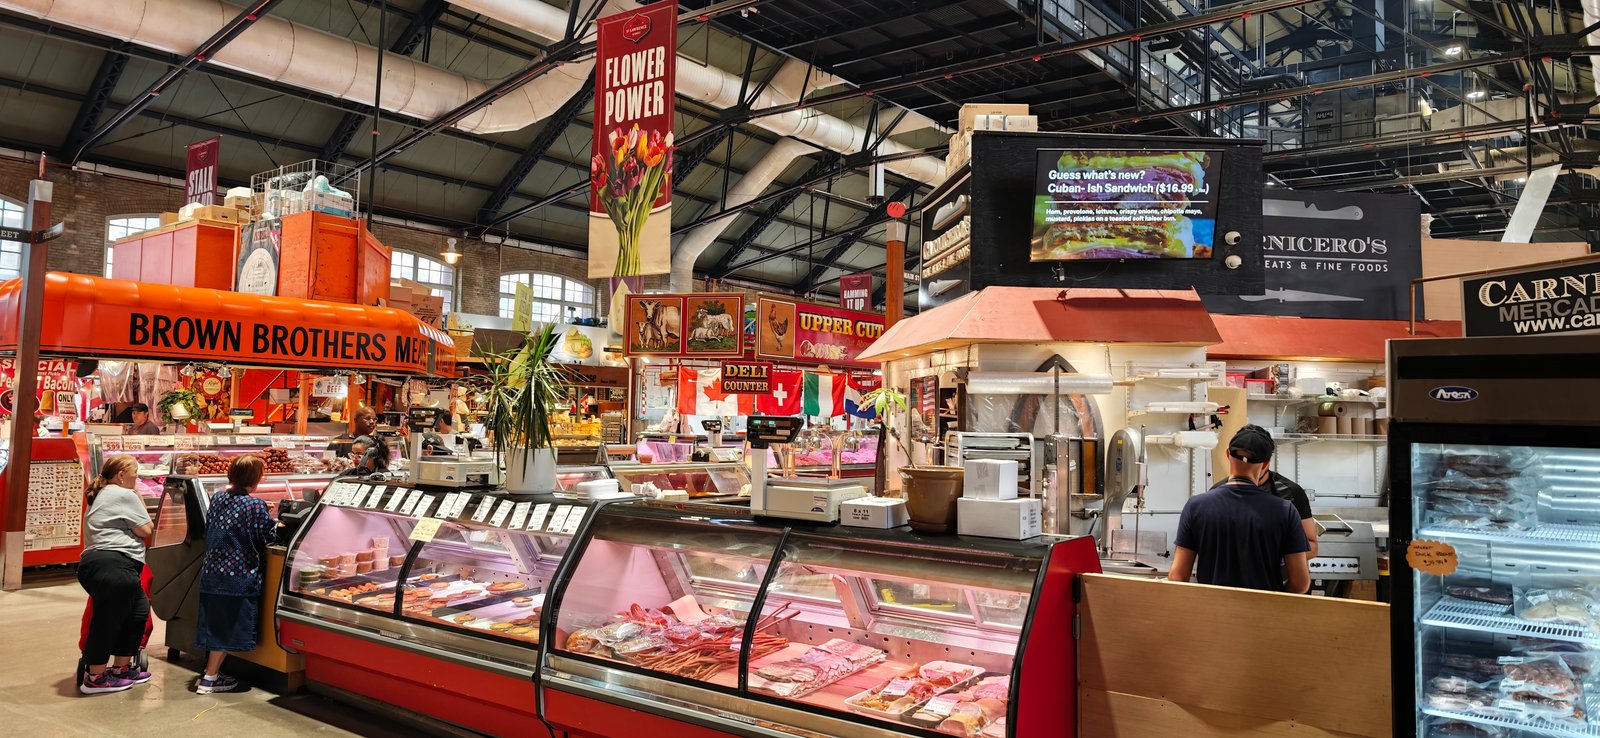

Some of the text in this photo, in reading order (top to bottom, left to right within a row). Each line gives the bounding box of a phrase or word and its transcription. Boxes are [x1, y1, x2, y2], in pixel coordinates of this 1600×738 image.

[605, 46, 665, 89] FLOWER
[605, 80, 665, 126] POWER
[188, 165, 214, 196] STALK
[1048, 170, 1146, 180] Guess what's new?
[1047, 183, 1086, 193] Cuban-
[1087, 183, 1103, 193] Ish
[1104, 183, 1153, 193] Sandwich
[1155, 183, 1194, 195] ($16.99
[1300, 261, 1308, 270] &
[1316, 262, 1342, 271] FINE
[1351, 263, 1389, 272] FOODS
[847, 299, 865, 310] IT UP
[799, 312, 884, 338] UPPER CUT
[129, 312, 241, 352] BROWN
[252, 323, 386, 362] BROTHERS
[1, 359, 77, 372] SCIAL
[725, 364, 769, 378] DELI
[43, 375, 75, 391] Bacon
[723, 381, 769, 391] COUNTER
[58, 394, 75, 403] ONLY
